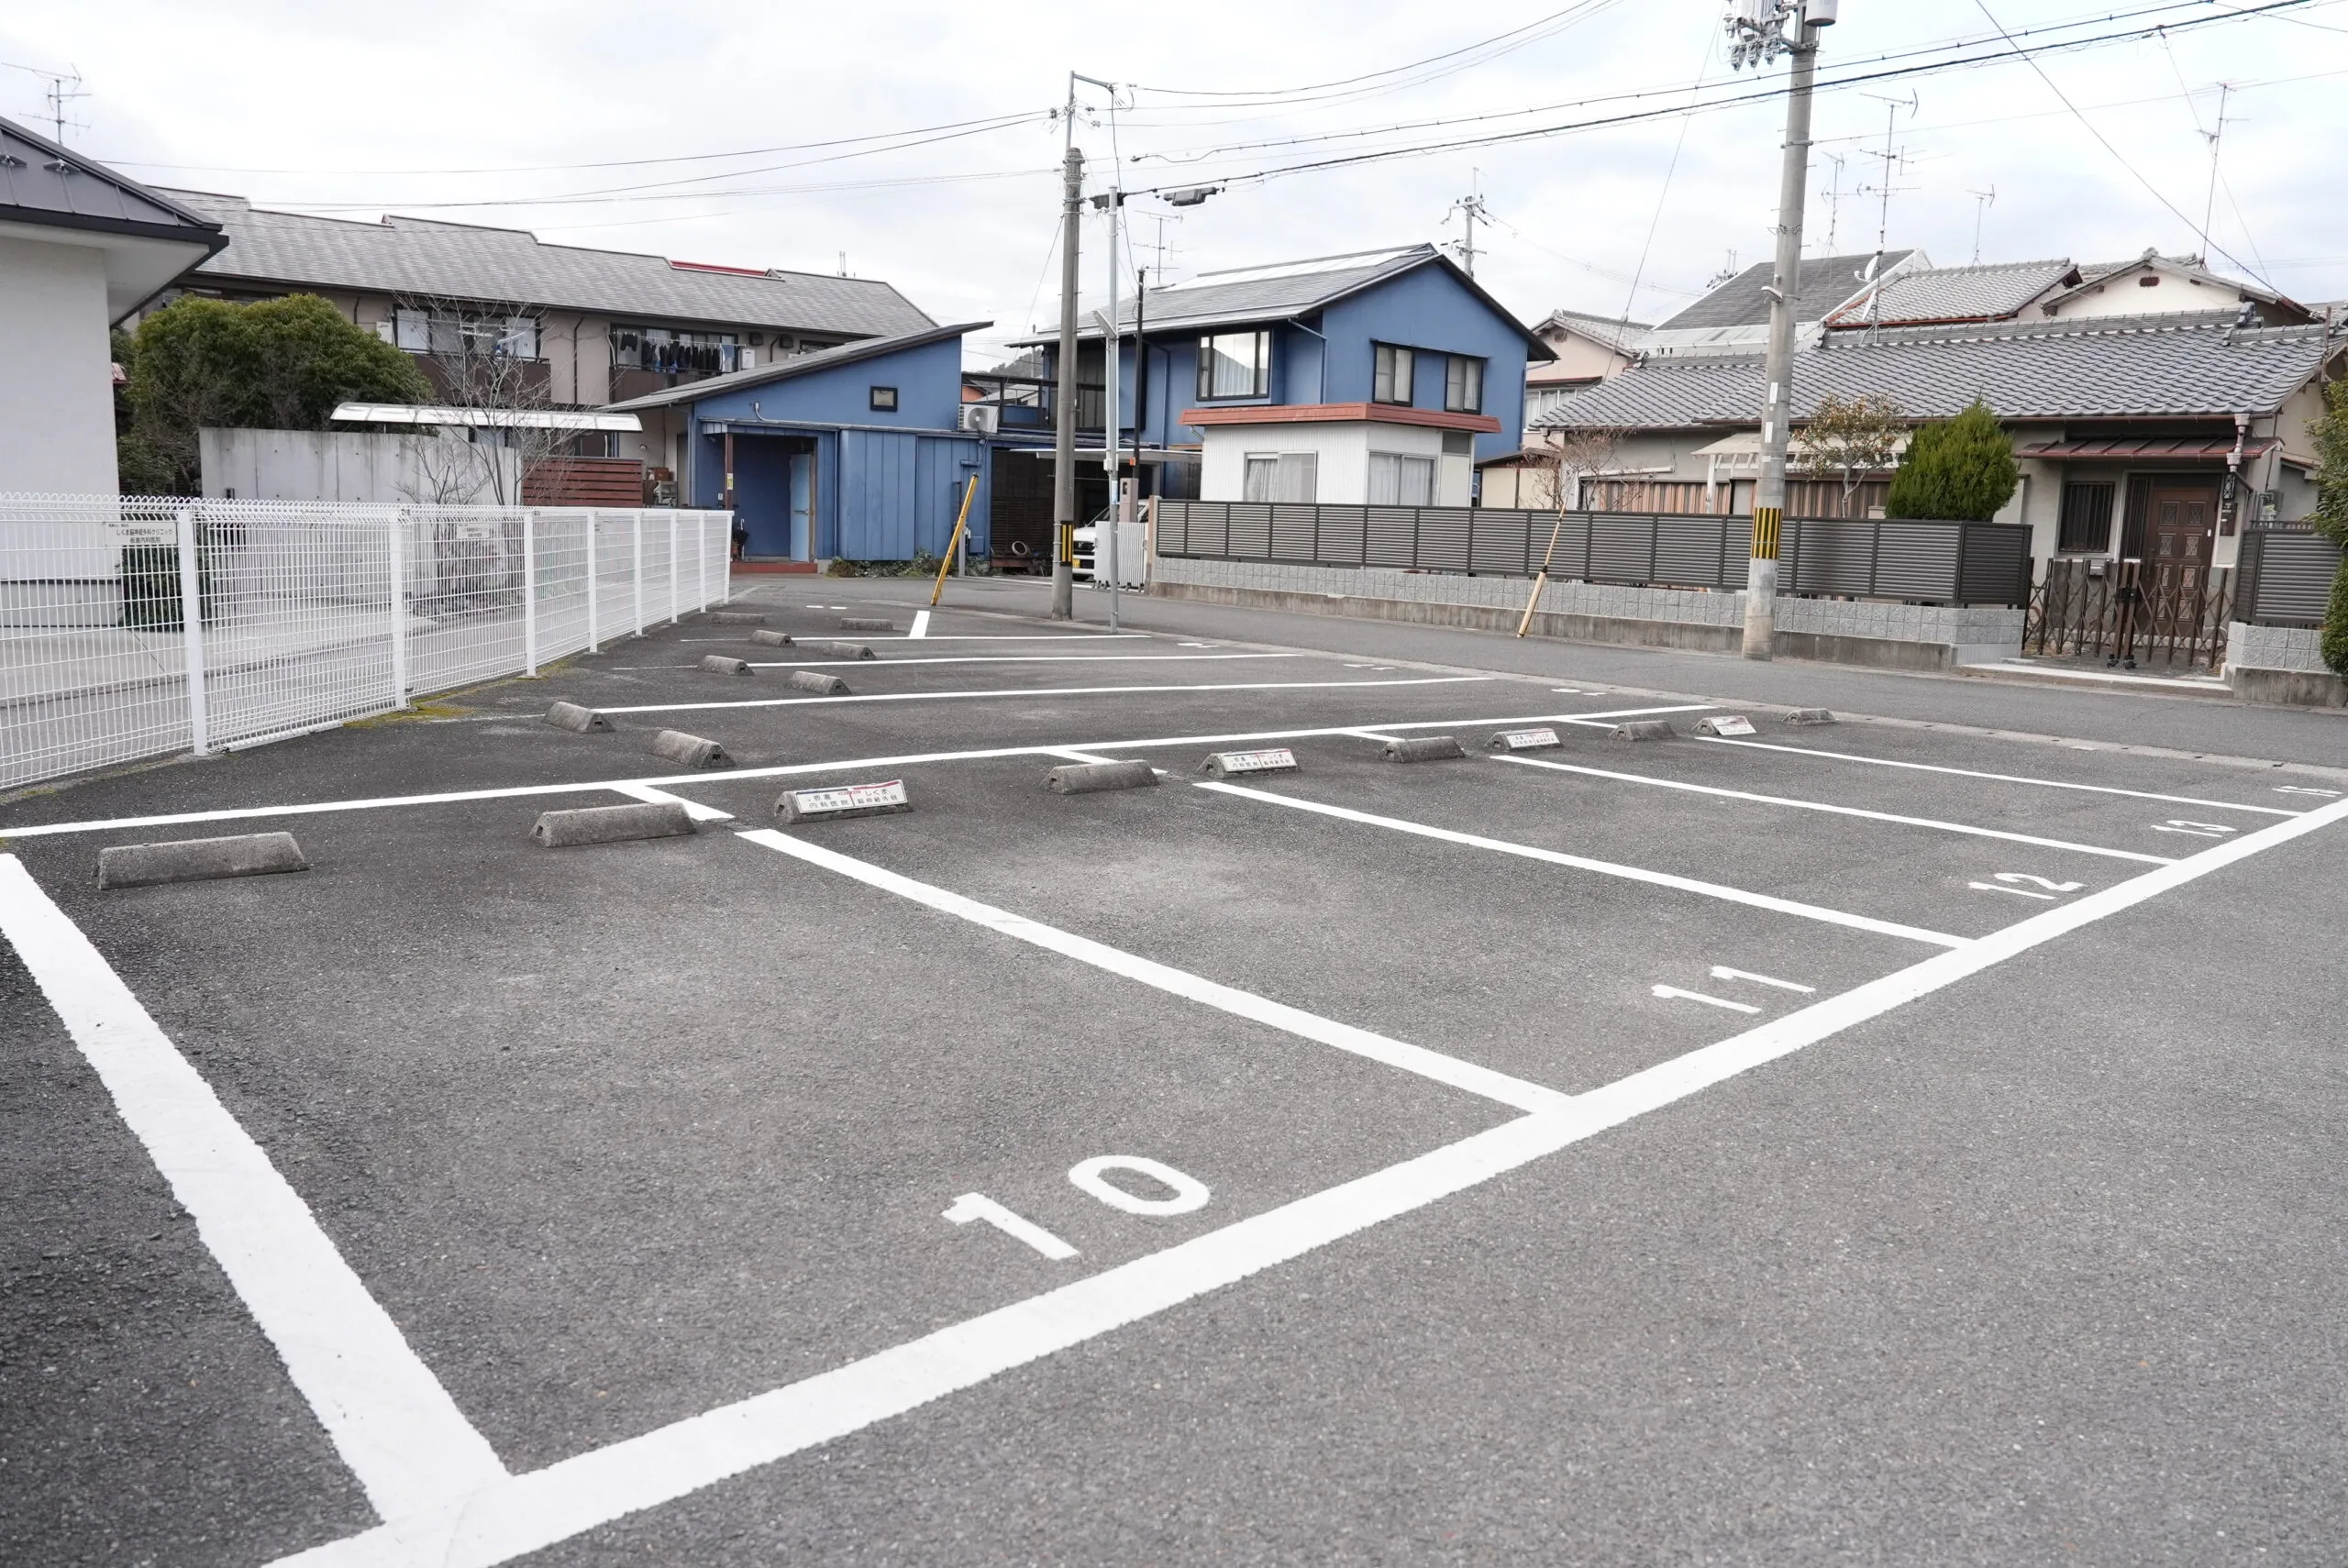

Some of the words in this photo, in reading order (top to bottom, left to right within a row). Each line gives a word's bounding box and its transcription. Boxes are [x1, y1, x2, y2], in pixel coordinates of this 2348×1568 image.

[2150, 819, 2237, 838] 13
[1967, 872, 2086, 900] 12
[1651, 966, 1817, 1014] 11
[941, 1154, 1211, 1261] 10
